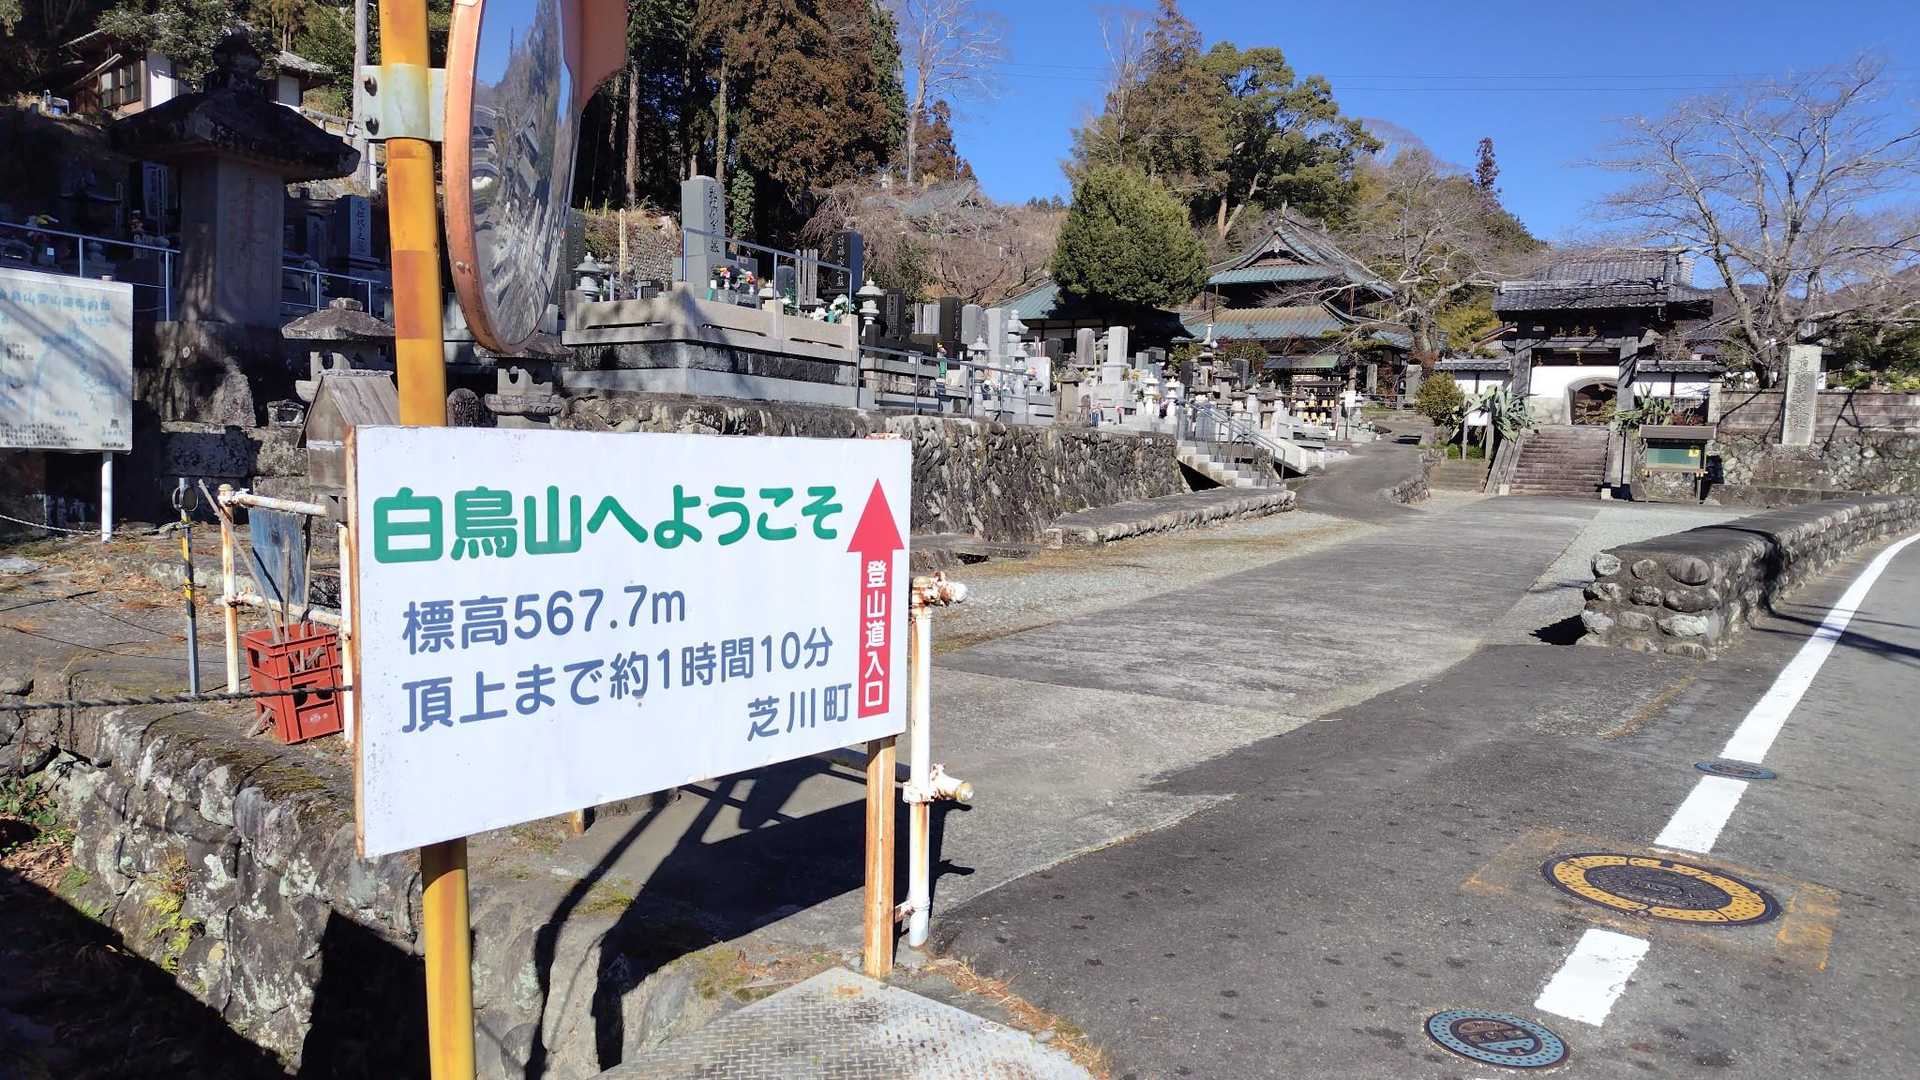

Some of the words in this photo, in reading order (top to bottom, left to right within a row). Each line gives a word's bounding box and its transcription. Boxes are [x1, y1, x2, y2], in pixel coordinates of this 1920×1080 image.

[373, 485, 843, 563] 白鳥山へようこそ
[403, 585, 685, 655] 標高567.7m
[864, 559, 887, 708] 登山道入口
[402, 628, 832, 733] 頂上まで約1時間10分
[747, 683, 852, 742] 芝川町
